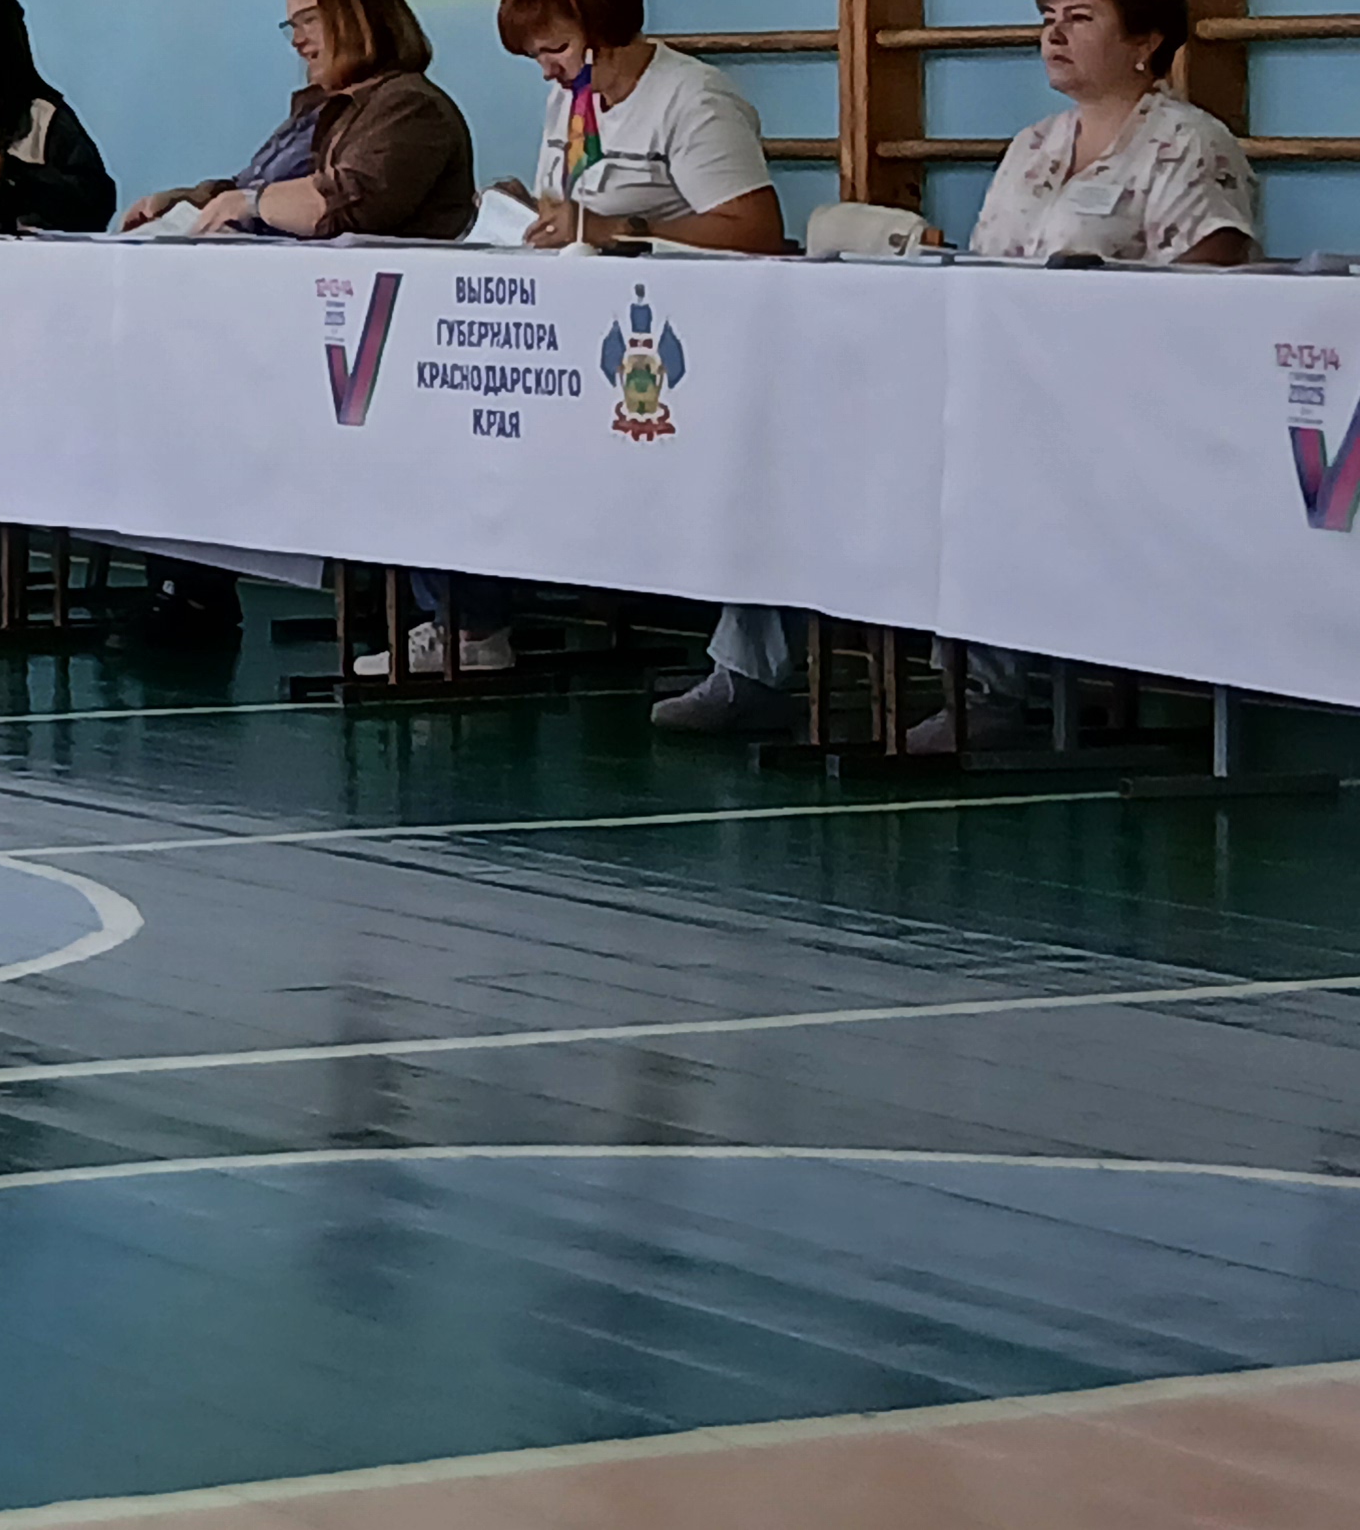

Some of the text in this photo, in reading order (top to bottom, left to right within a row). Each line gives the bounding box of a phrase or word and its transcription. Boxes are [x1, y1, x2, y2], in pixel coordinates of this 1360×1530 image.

[455, 276, 536, 305] ВЫБОРЫ
[436, 319, 559, 351] ГУБЕРНАТОРА
[416, 361, 582, 397] КРАСНОДАРСКОГО
[473, 409, 521, 438] КРАЯ
